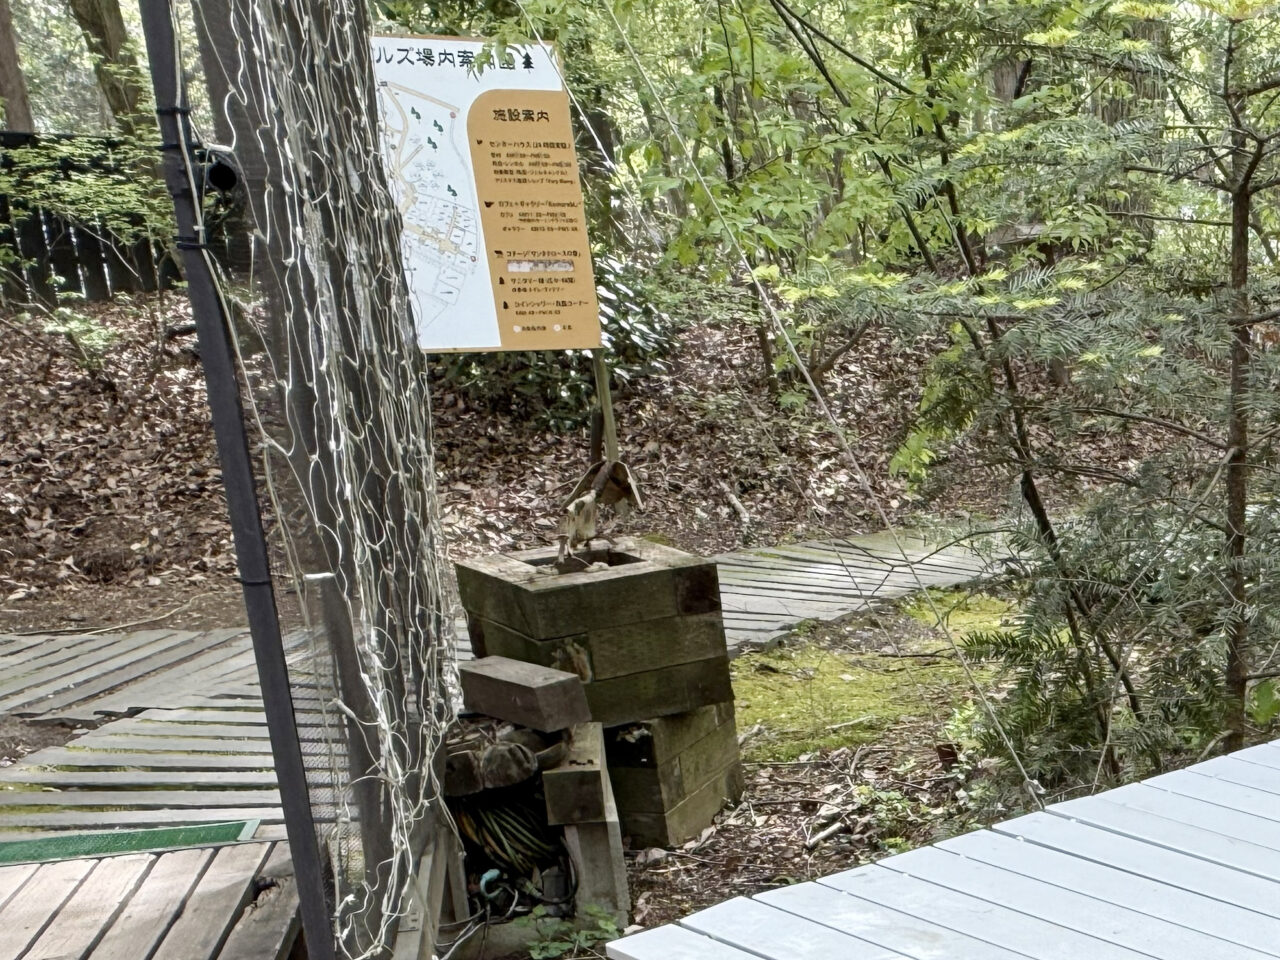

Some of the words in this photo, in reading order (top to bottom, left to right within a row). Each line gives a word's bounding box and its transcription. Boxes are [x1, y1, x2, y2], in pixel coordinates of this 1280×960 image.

[376, 46, 515, 70] ルズ場内案
[492, 109, 550, 122] 施設案内
